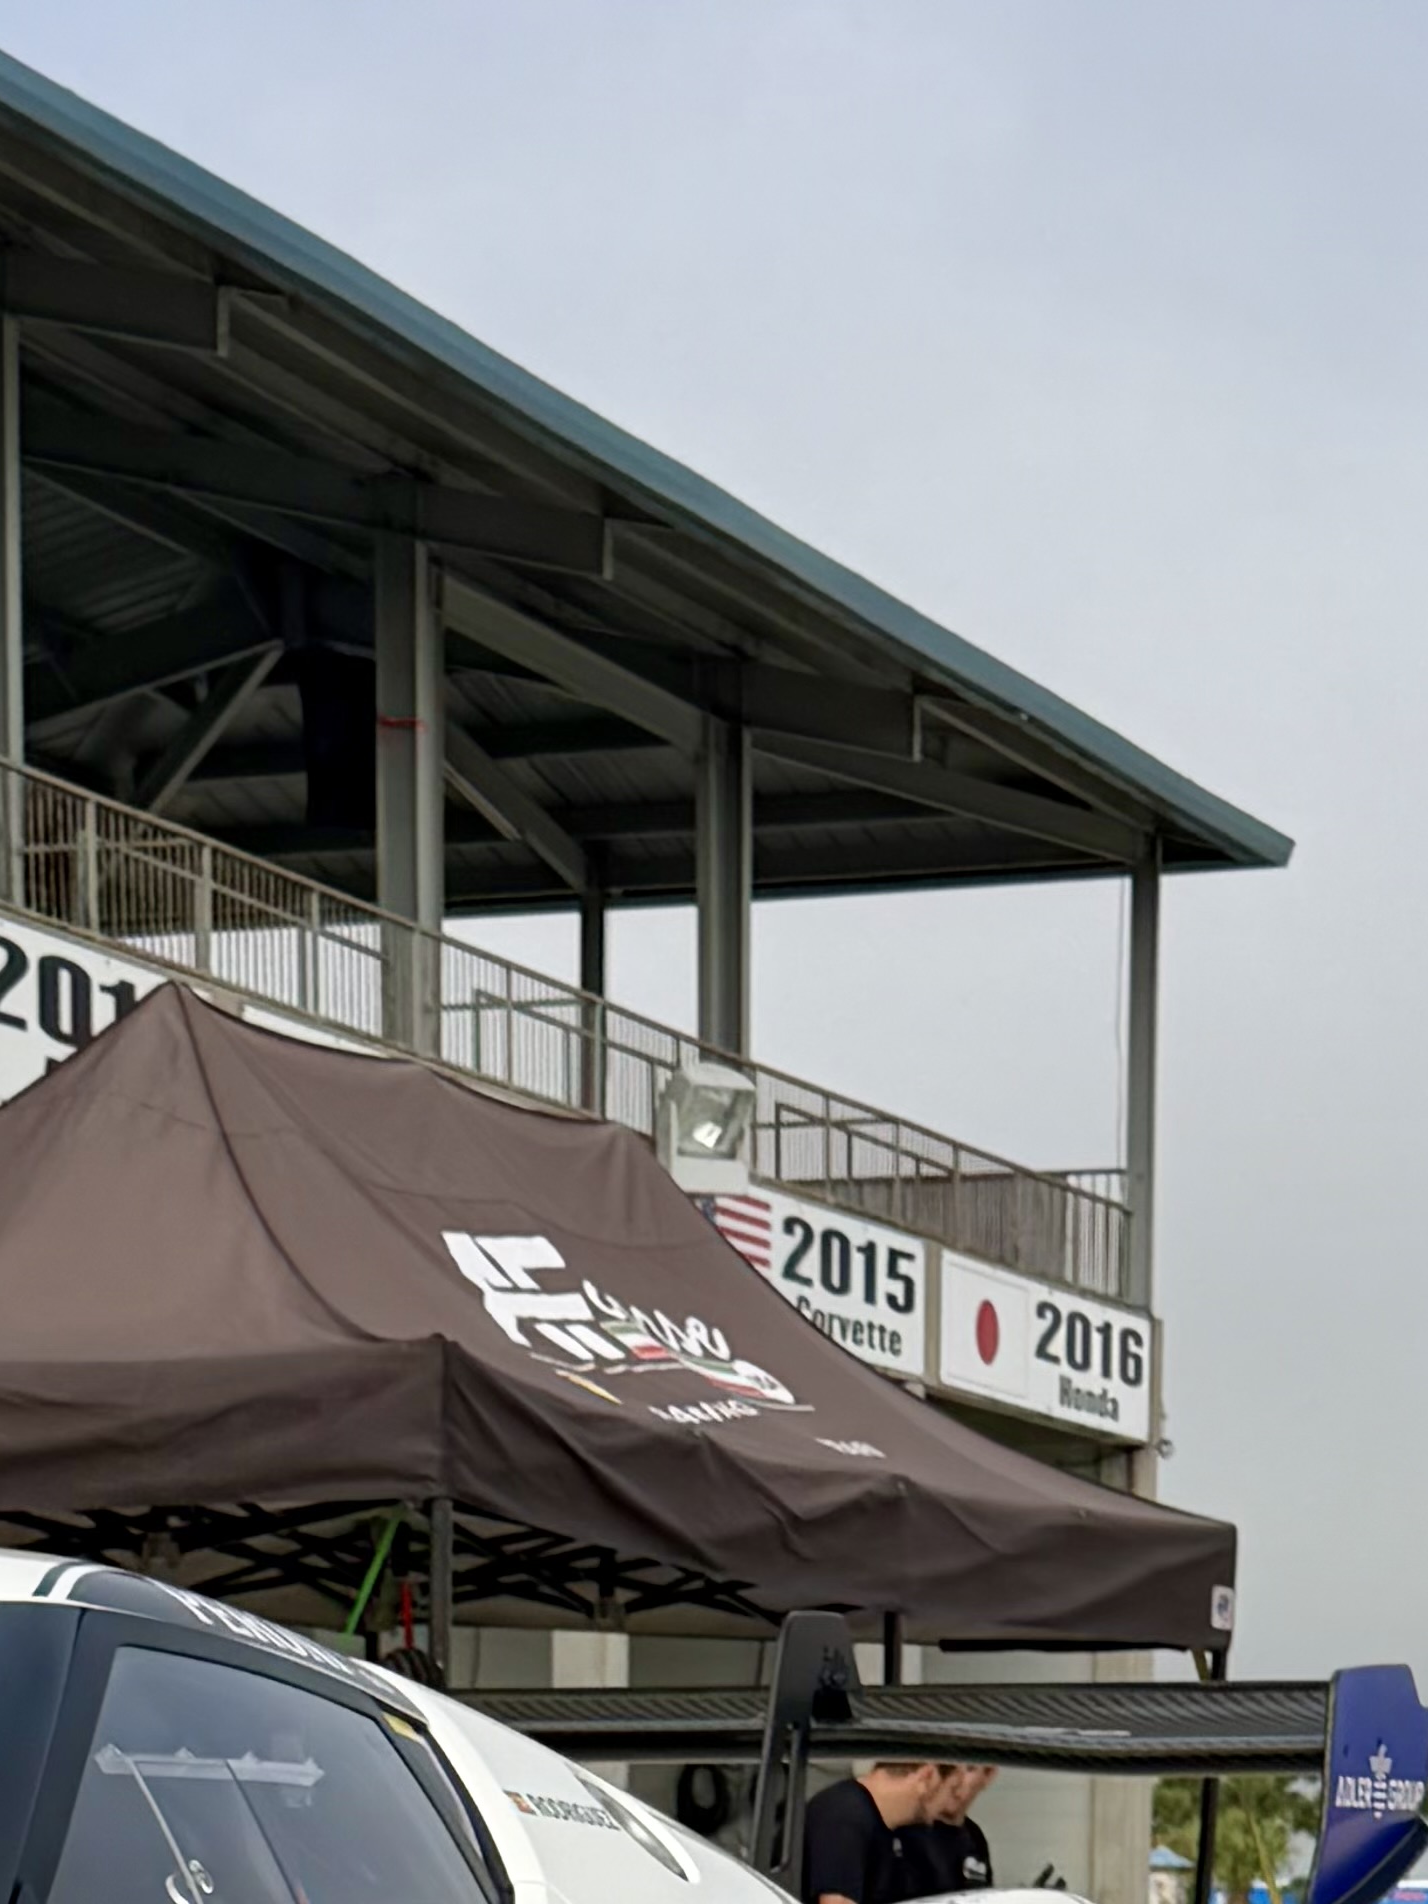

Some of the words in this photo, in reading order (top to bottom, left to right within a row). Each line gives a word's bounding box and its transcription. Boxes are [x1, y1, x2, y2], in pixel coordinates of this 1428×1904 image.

[782, 1216, 916, 1314] 2015
[796, 1296, 903, 1358] Corvette
[1035, 1301, 1145, 1389] 2016
[1059, 1375, 1120, 1423] Honda
[1335, 1775, 1372, 1808] ADLER
[1387, 1779, 1425, 1811] GROUP
